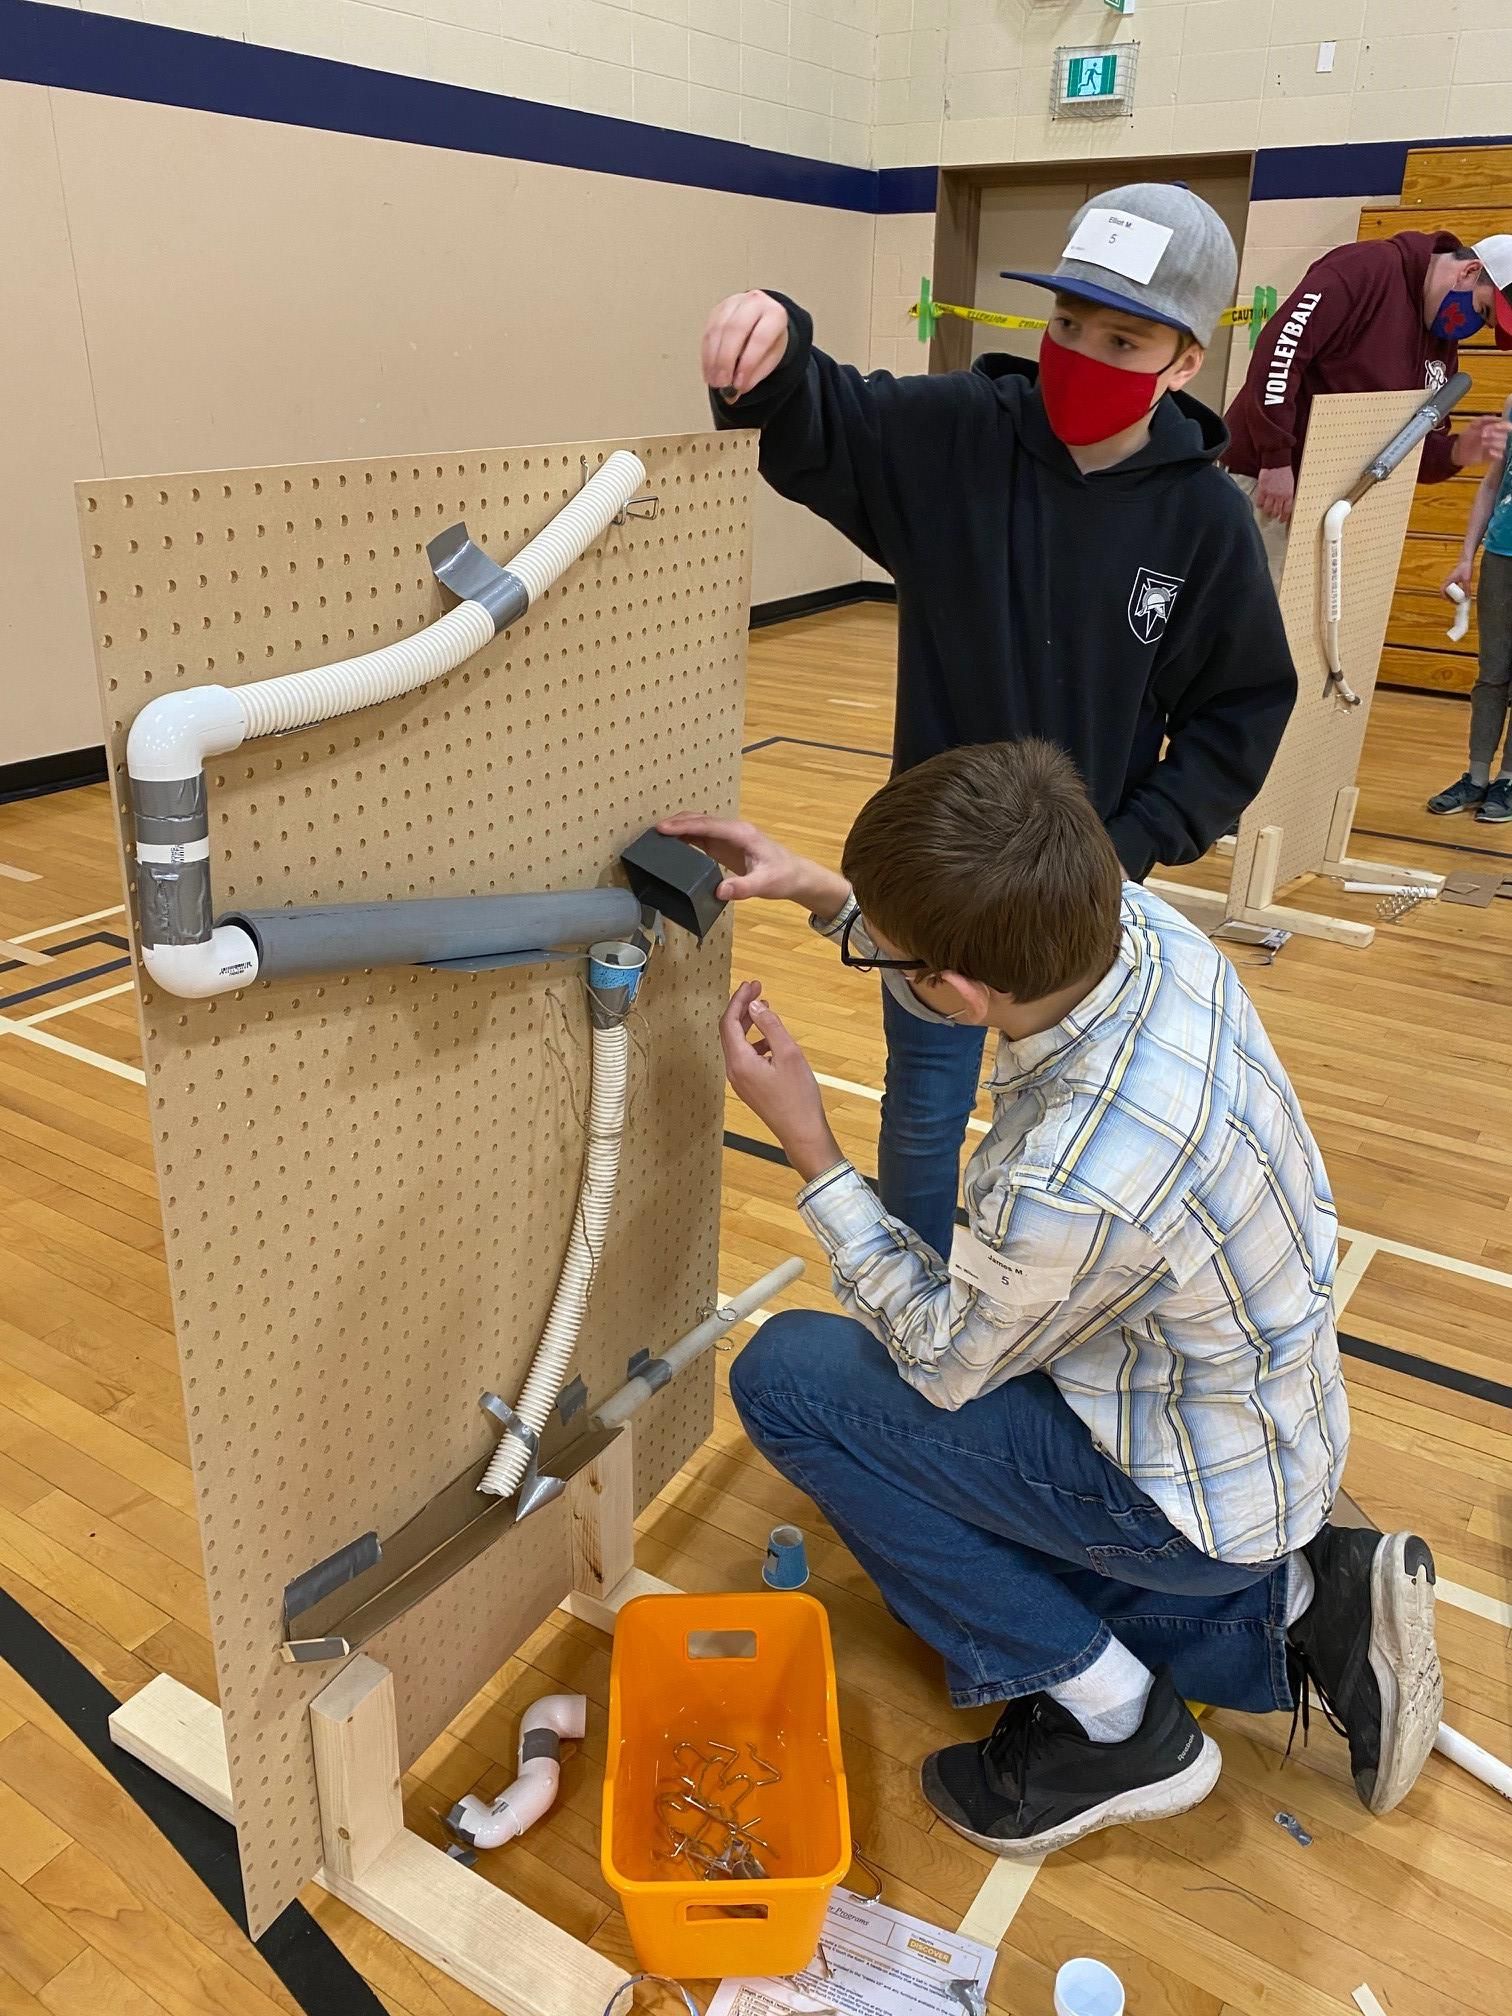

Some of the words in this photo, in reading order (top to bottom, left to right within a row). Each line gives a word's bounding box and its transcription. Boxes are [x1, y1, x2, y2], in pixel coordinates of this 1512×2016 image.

[1108, 233, 1117, 244] 5
[1232, 309, 1267, 322] CAUT
[1264, 293, 1322, 405] VOLLEYBALL
[987, 1255, 1012, 1272] James
[1001, 1276, 1009, 1286] 5
[1177, 1734, 1194, 1761] Reebok
[834, 1907, 871, 1926] Programs
[908, 1940, 950, 1962] DISCOVER
